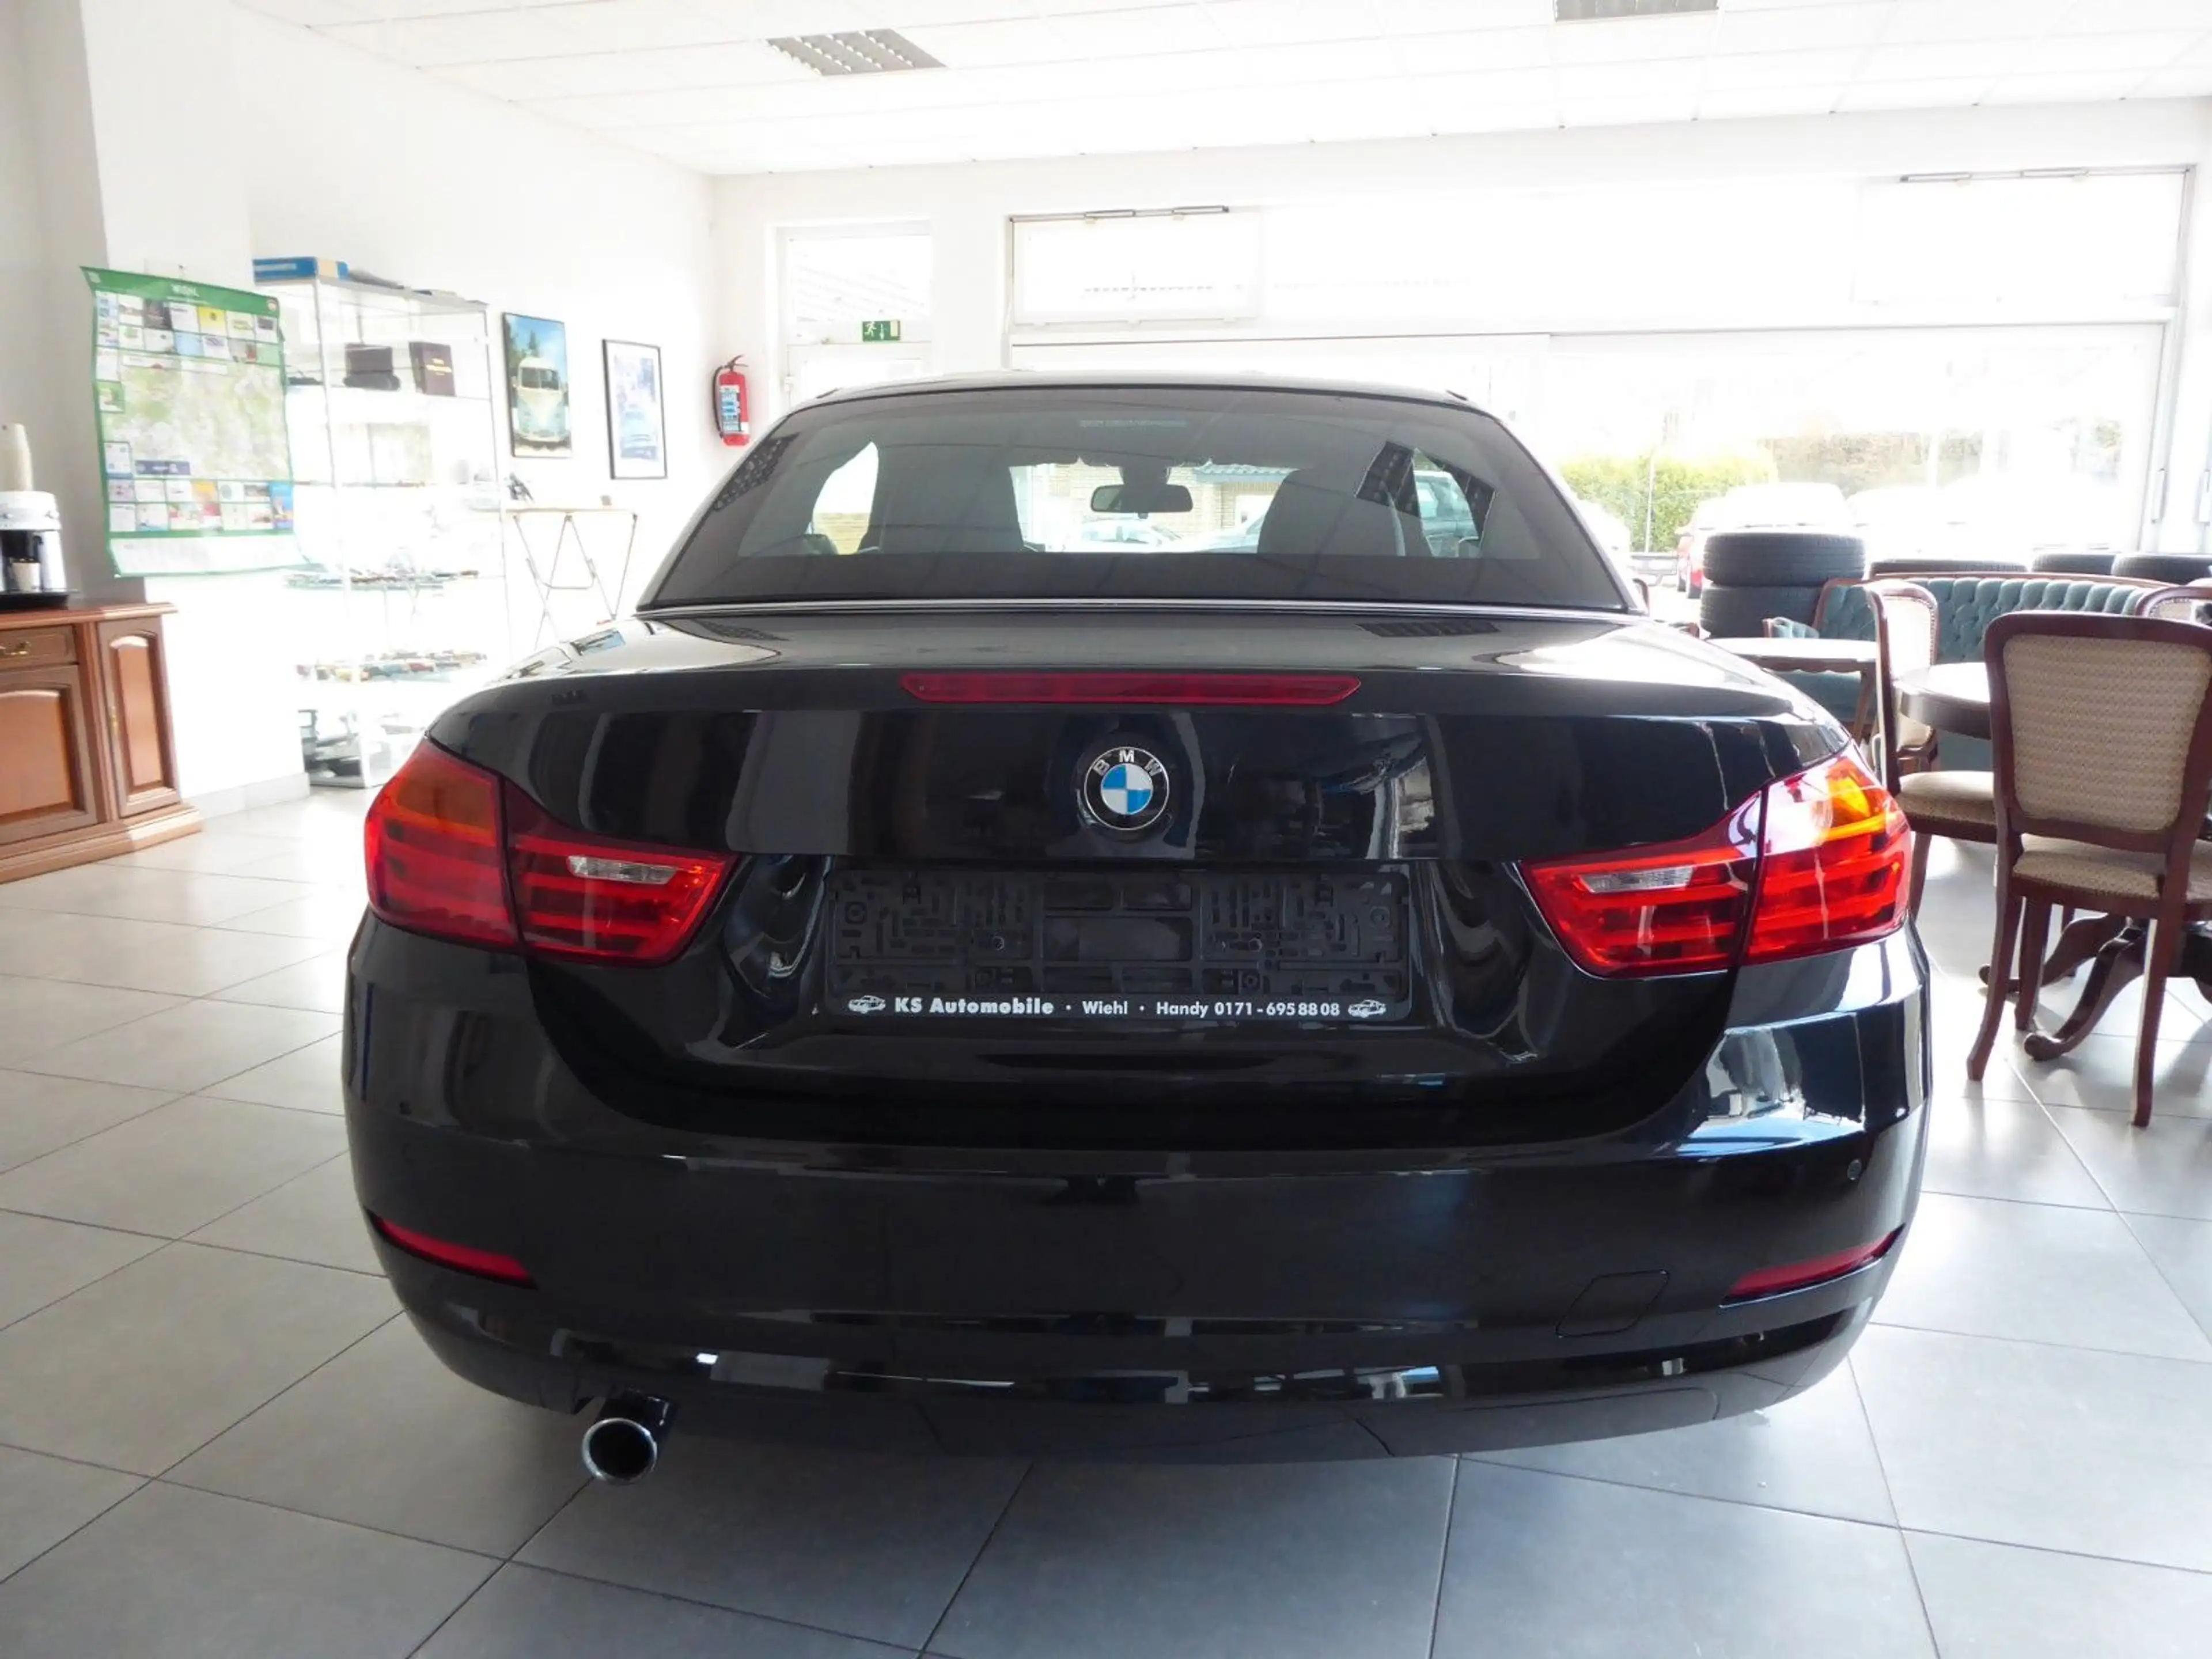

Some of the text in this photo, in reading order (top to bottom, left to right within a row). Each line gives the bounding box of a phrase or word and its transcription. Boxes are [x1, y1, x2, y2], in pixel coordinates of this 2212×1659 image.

[1092, 749, 1162, 777] BMW
[895, 997, 923, 1013] KS
[929, 997, 1054, 1014] Automobile
[1082, 1000, 1128, 1015] Wiehl
[1156, 1001, 1209, 1018] Handy
